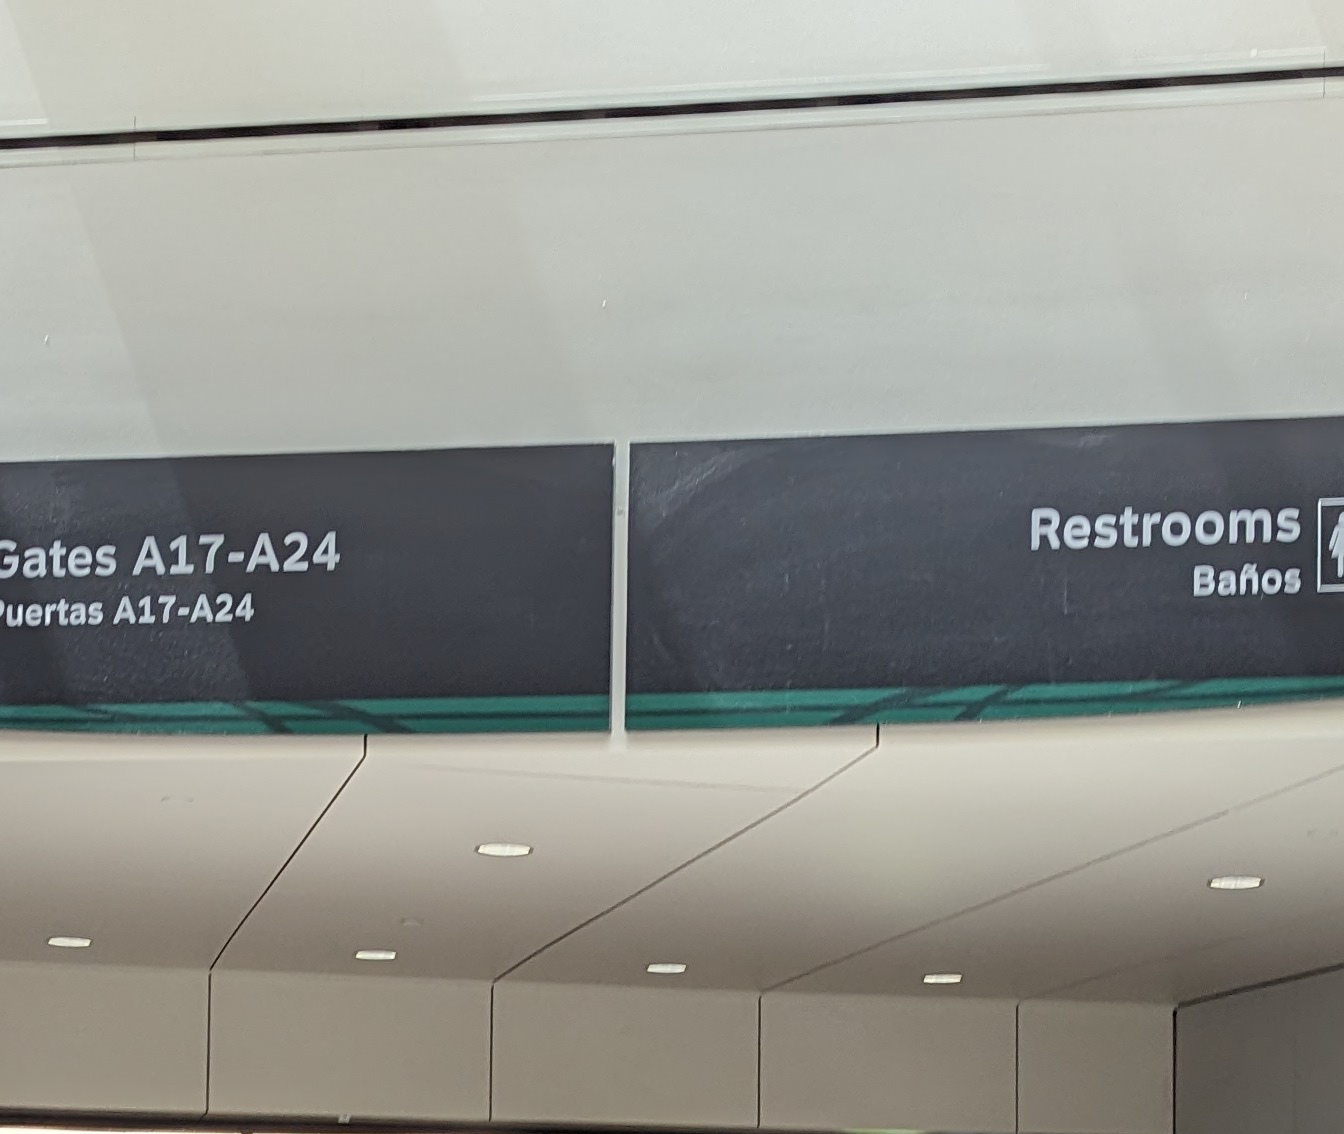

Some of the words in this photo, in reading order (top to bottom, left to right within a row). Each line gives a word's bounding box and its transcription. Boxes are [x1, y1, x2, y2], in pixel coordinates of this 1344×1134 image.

[1030, 503, 1302, 551] Restrooms
[132, 530, 341, 577] A17-A24
[1193, 562, 1302, 599] Baños
[112, 592, 255, 627] A17-A24
